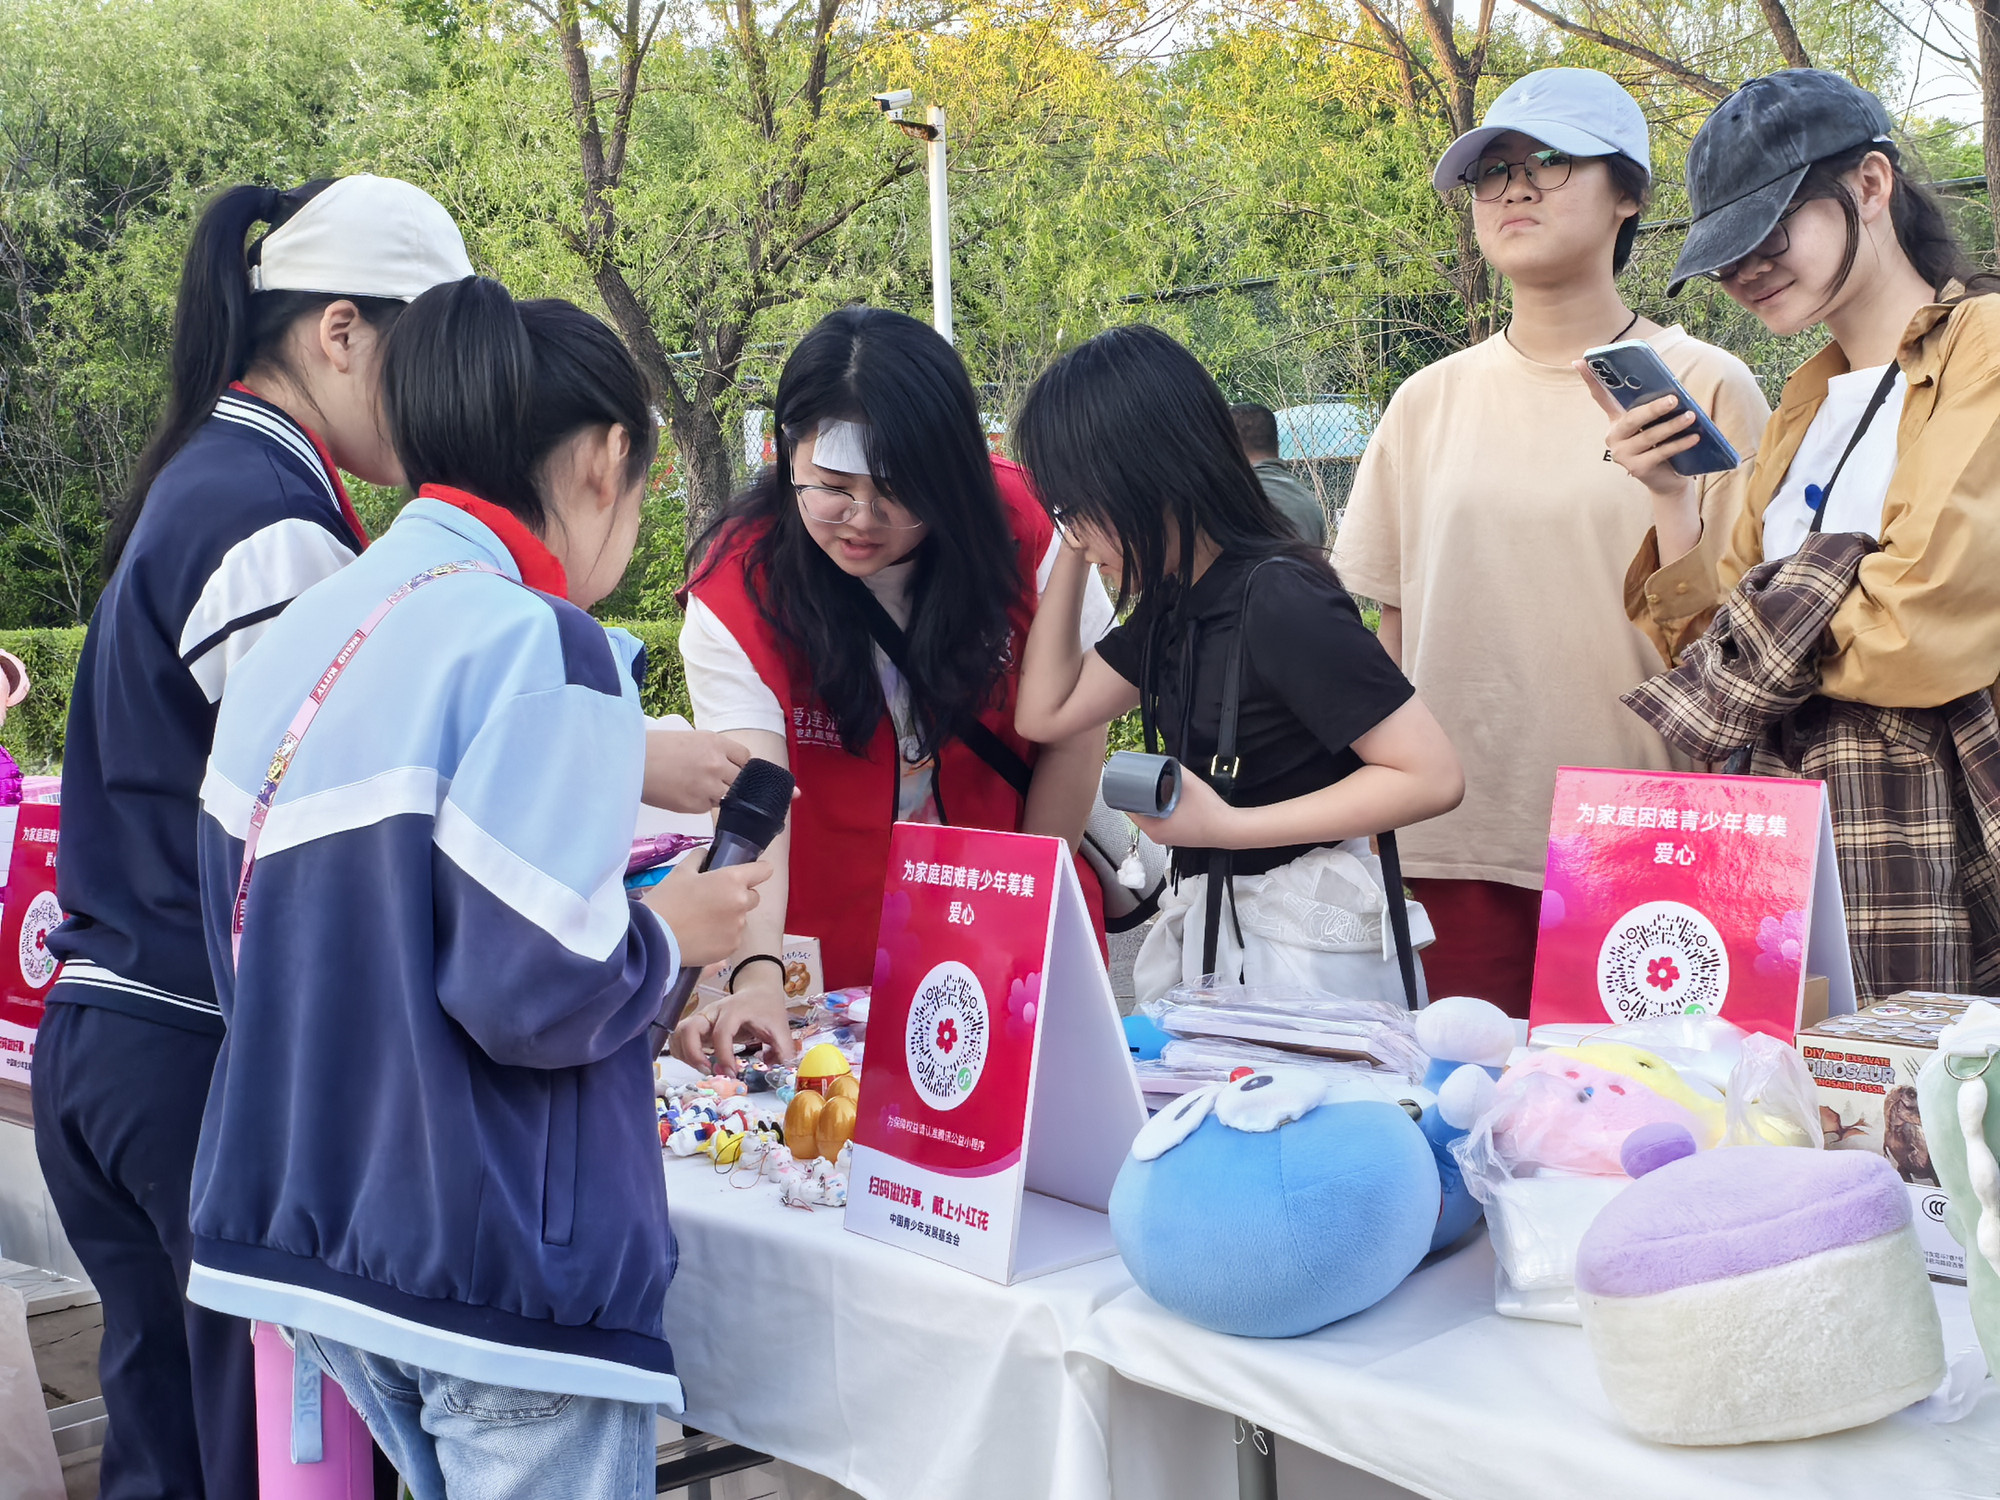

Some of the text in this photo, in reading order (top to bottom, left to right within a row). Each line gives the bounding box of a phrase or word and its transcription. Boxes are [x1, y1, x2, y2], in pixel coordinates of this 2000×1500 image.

[316, 636, 361, 697] HELLO KITTY
[1576, 803, 1789, 838] 为家庭困难青少年筹集
[1653, 842, 1697, 866] 爱心
[902, 859, 1036, 898] 为家庭困难青少年筹集
[947, 901, 975, 926] 爱心
[1804, 1046, 1824, 1059] DIY
[1824, 1051, 1844, 1061] AND
[1855, 1082, 1886, 1095] FOSSIL
[889, 1213, 961, 1247] 中国青少年发展基金会
